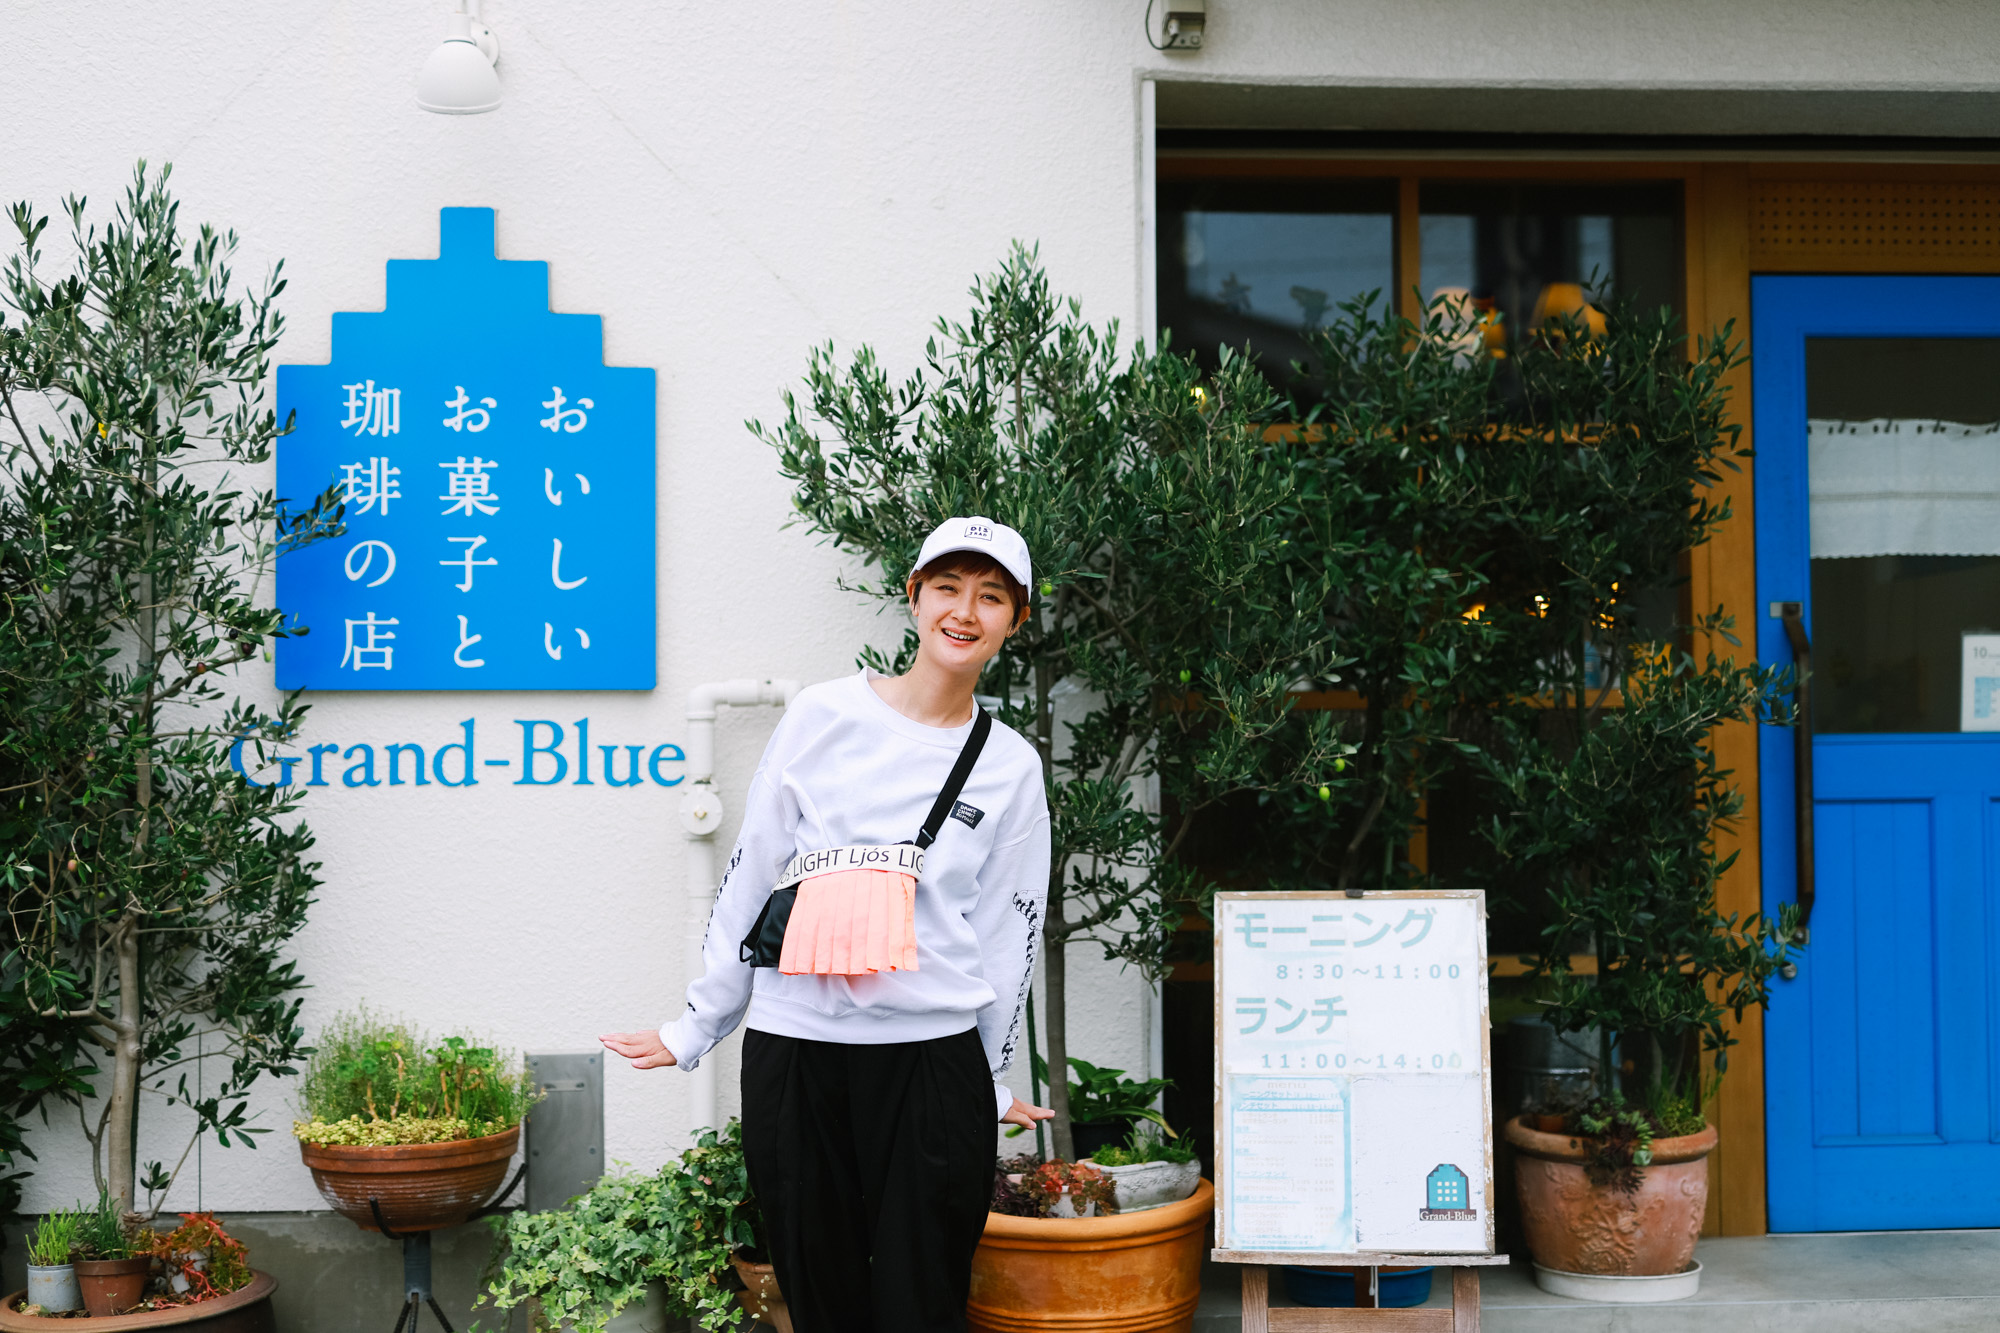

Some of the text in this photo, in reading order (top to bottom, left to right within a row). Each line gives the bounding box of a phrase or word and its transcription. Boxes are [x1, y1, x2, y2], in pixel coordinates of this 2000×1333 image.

[339, 379, 402, 672] 珈琲の店
[438, 384, 501, 669] お菓子と
[540, 385, 595, 662] おいしい
[230, 717, 686, 789] Grand-Blue
[793, 848, 843, 878] LIGHT
[849, 847, 890, 867] Ljós
[1233, 906, 1438, 949] モーニング
[1235, 995, 1348, 1035] ランチ
[1420, 1210, 1476, 1221] Grand-Blue
